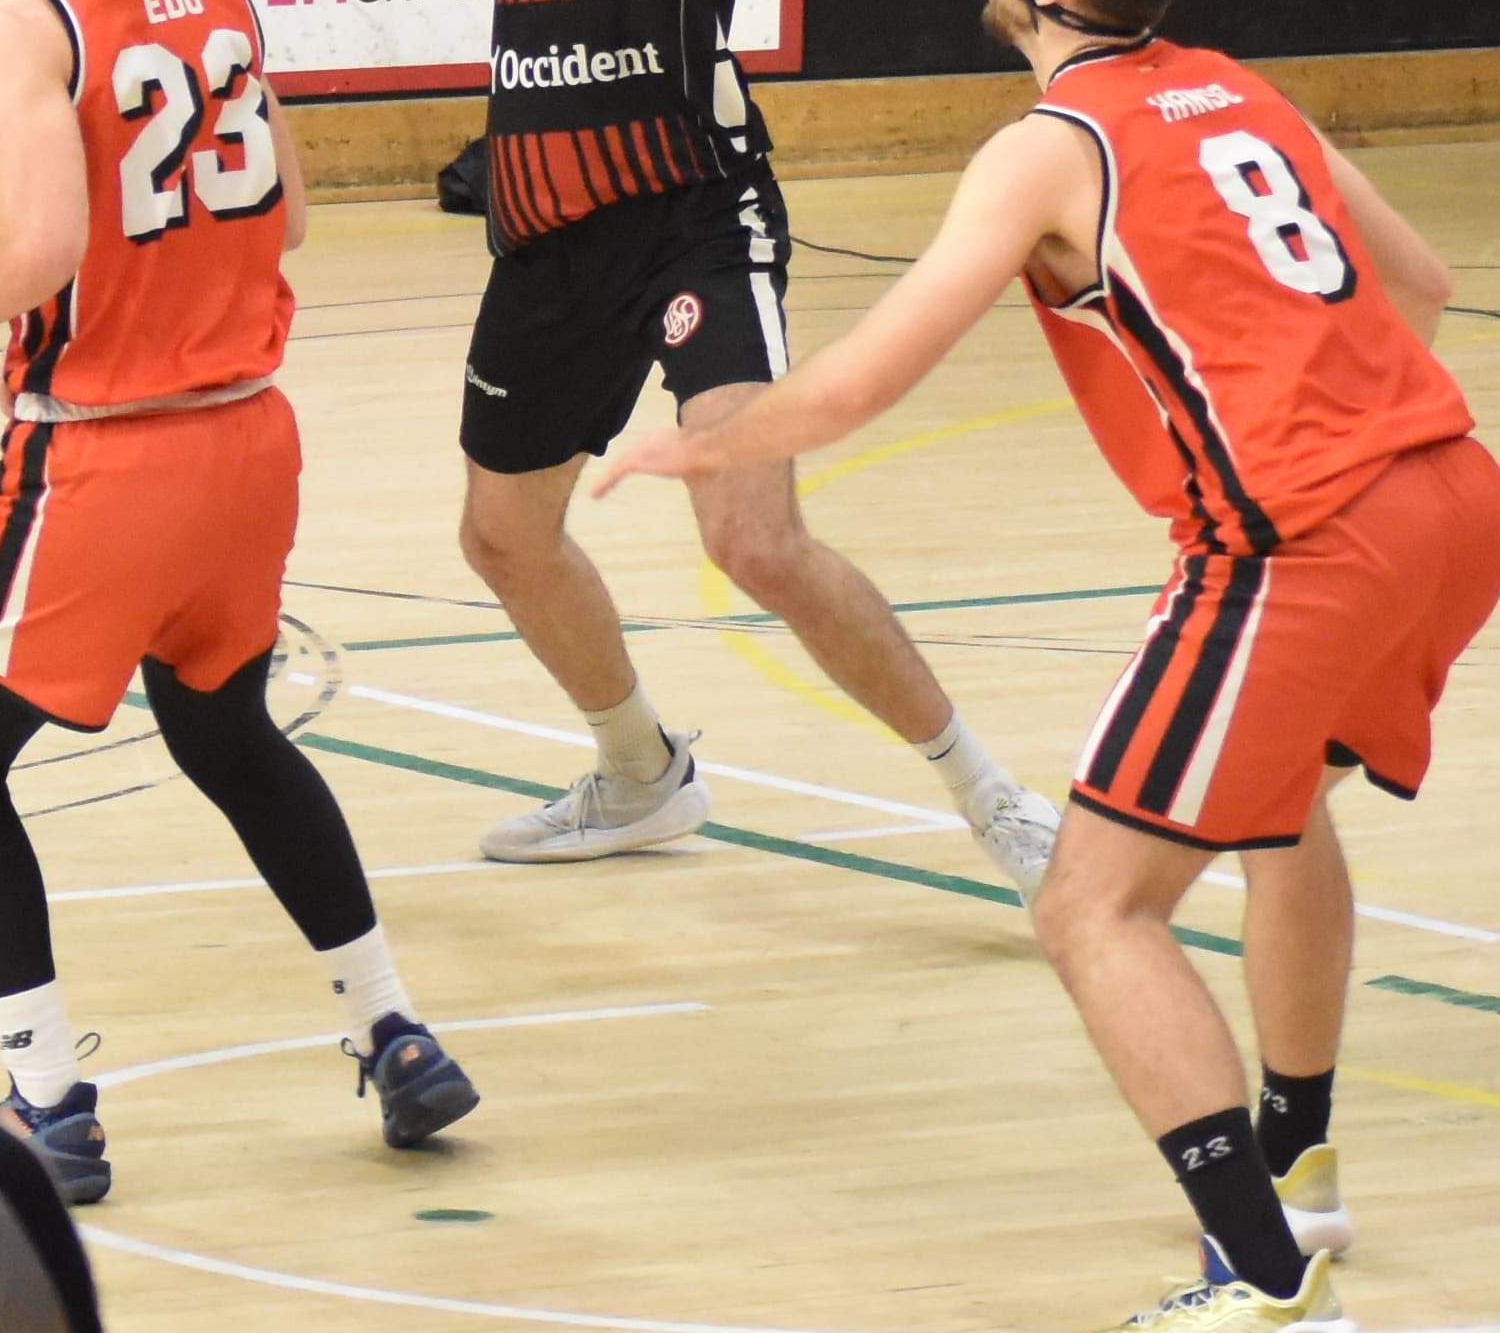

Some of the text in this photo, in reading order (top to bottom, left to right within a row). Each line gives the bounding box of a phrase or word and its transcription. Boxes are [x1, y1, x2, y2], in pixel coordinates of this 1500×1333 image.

[500, 42, 664, 90] Occident
[111, 28, 283, 244] 23
[1199, 130, 1357, 304] 8
[1181, 1136, 1232, 1171] 23
